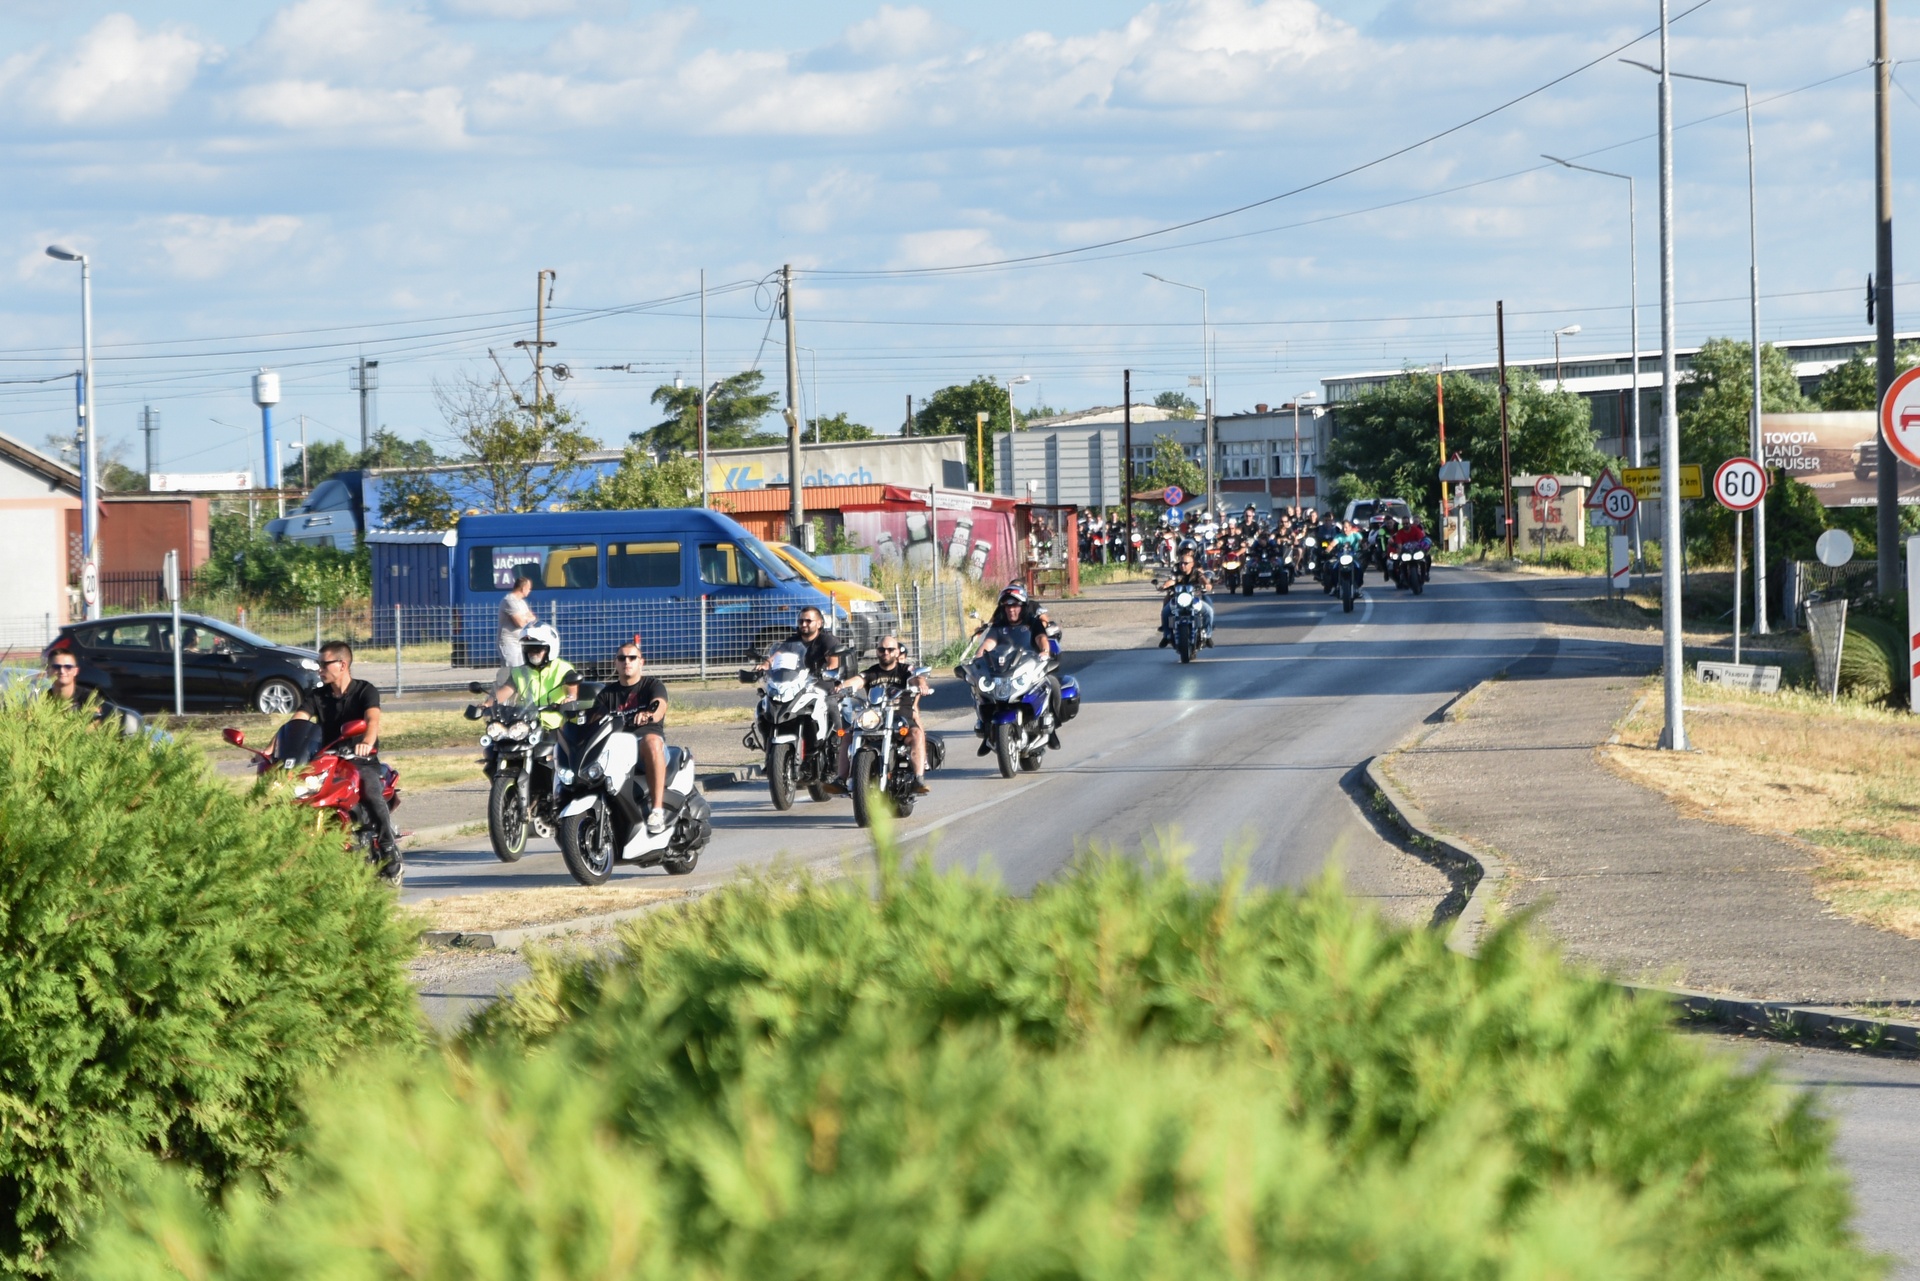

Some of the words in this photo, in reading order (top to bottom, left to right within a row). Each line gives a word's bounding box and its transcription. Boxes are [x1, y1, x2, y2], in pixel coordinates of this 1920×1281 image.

[1764, 432, 1818, 444] TOYOTA
[1764, 446, 1802, 457] LAND
[1764, 457, 1820, 469] CRUISER
[1725, 471, 1755, 497] 60
[1610, 495, 1630, 512] 30
[86, 575, 95, 593] 20
